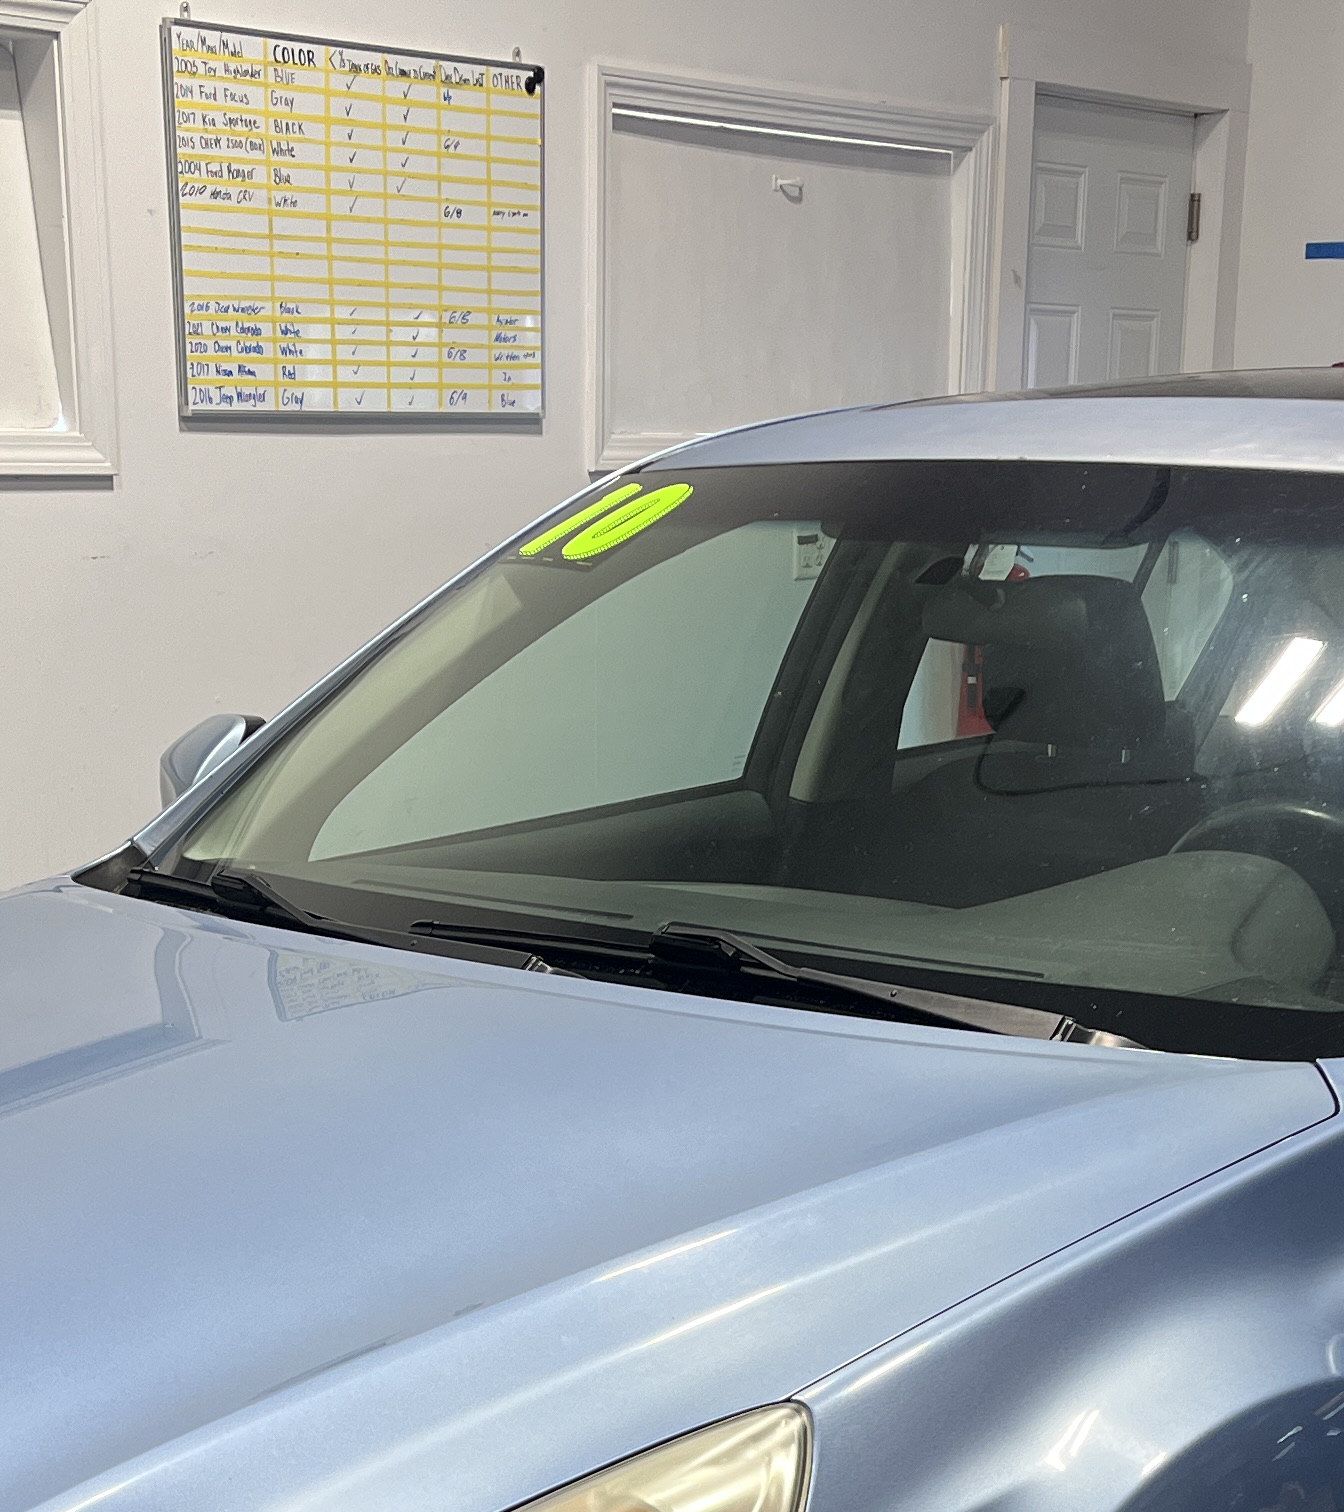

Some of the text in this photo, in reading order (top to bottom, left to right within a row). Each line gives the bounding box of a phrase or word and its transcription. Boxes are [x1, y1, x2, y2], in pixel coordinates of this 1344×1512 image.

[273, 44, 317, 67] COLOR
[492, 74, 523, 91] OTHER
[199, 84, 217, 102] Ford
[224, 88, 250, 105] Focus
[271, 89, 294, 113] Gray
[176, 110, 260, 132] 2017 Kia Sportage
[270, 139, 296, 158] White
[178, 160, 202, 176] 2004
[206, 161, 224, 179] Ford
[236, 189, 254, 204] CRV
[519, 482, 694, 560] 10
